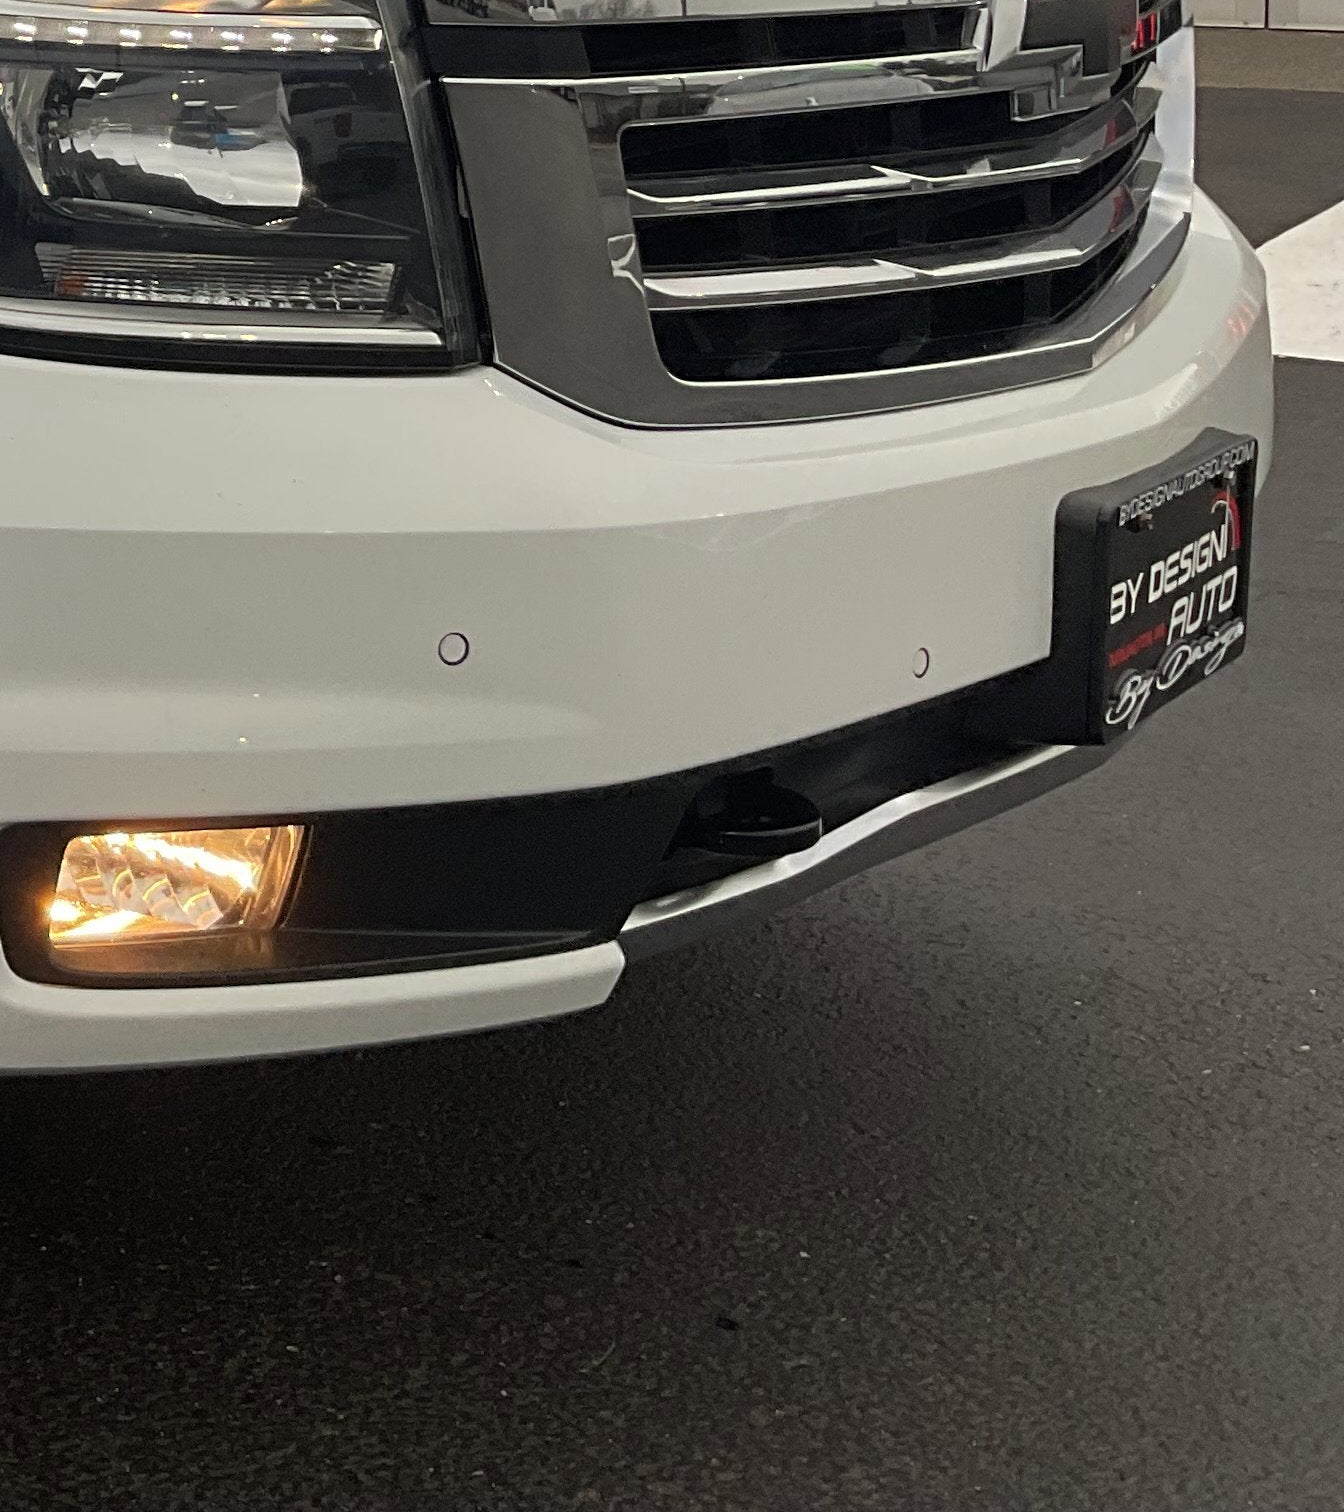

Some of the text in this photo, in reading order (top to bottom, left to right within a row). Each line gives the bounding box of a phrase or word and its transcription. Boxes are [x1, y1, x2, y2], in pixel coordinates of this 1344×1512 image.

[1110, 523, 1229, 625] BY DESIGN
[1166, 565, 1238, 646] AUTO
